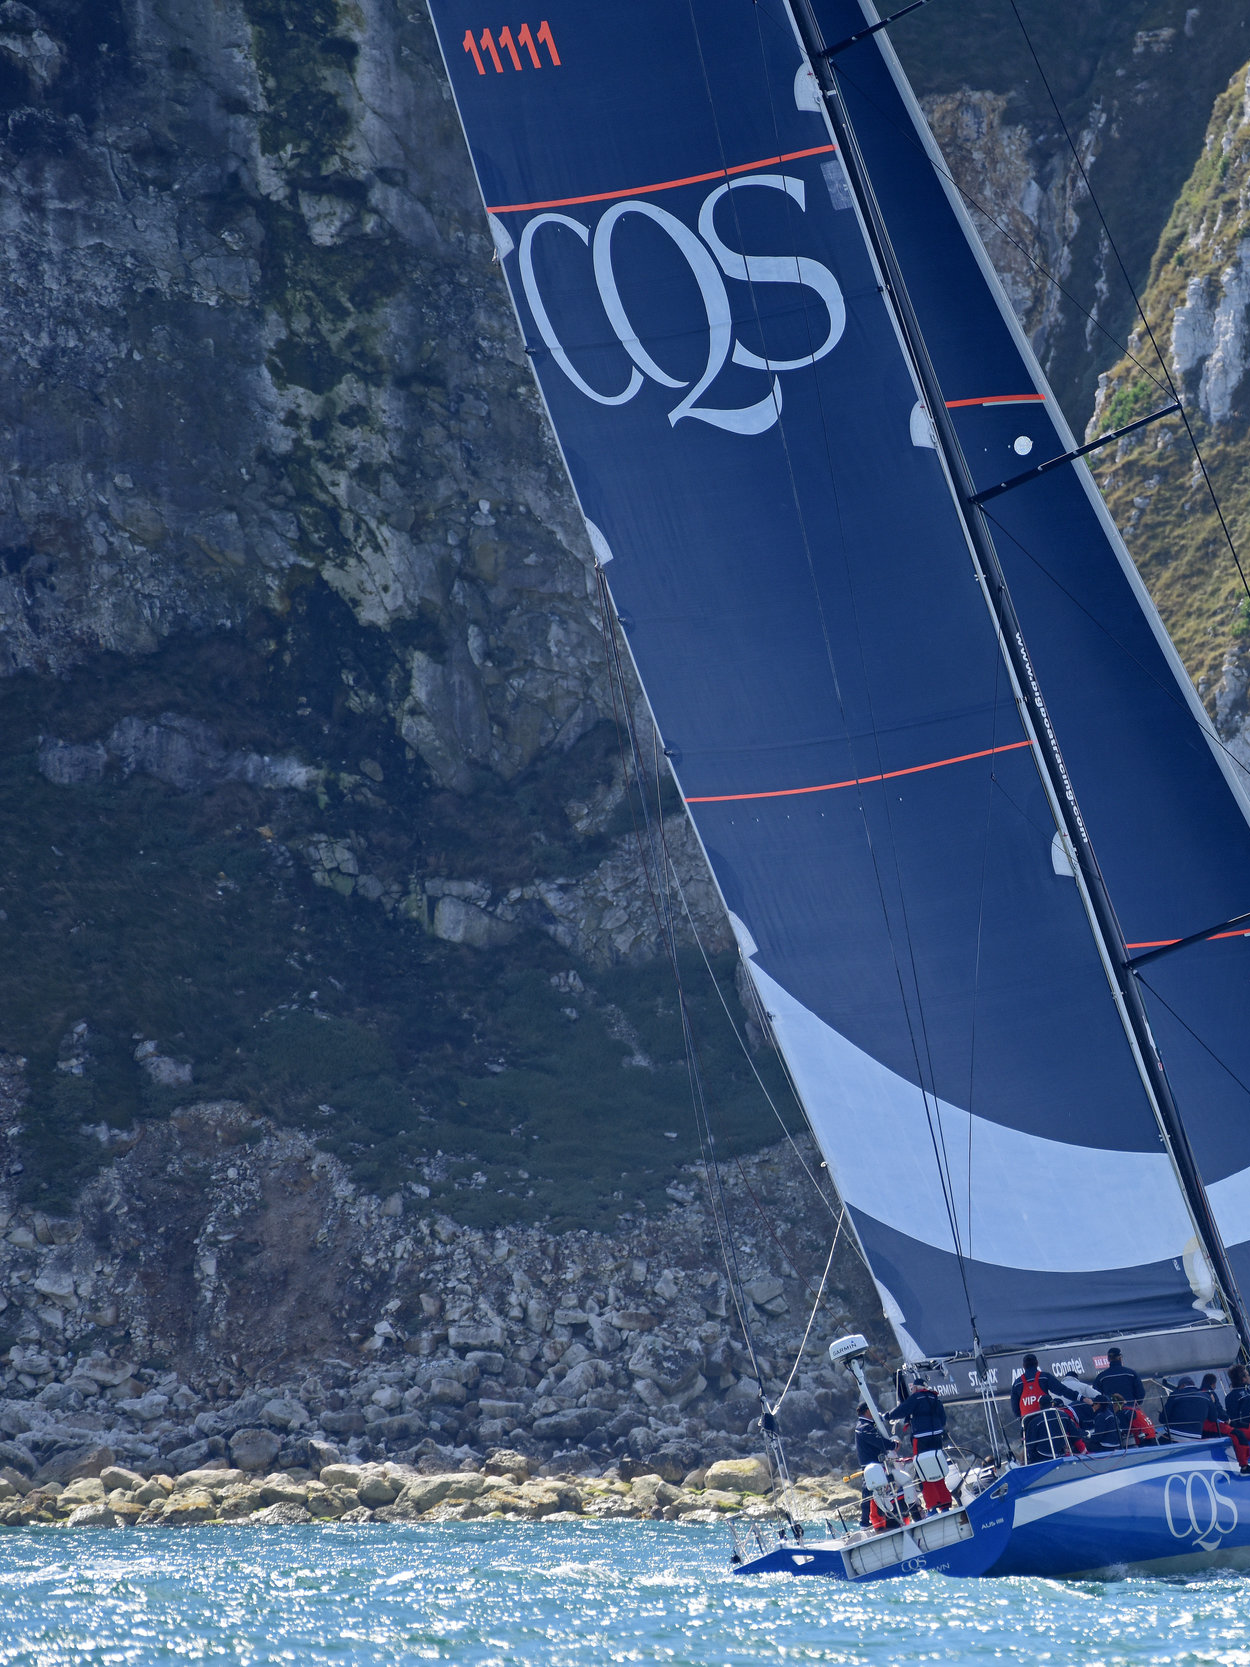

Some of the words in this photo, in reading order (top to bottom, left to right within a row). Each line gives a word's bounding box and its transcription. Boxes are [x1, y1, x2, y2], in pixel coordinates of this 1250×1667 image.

[462, 20, 561, 76] 11111
[518, 174, 847, 435] CQS
[1015, 631, 1089, 843] www.bigboatracing.com
[832, 1342, 857, 1356] GARMIN
[1022, 1395, 1037, 1407] VIP
[1164, 1470, 1239, 1551] CQS
[900, 1556, 927, 1574] CQS
